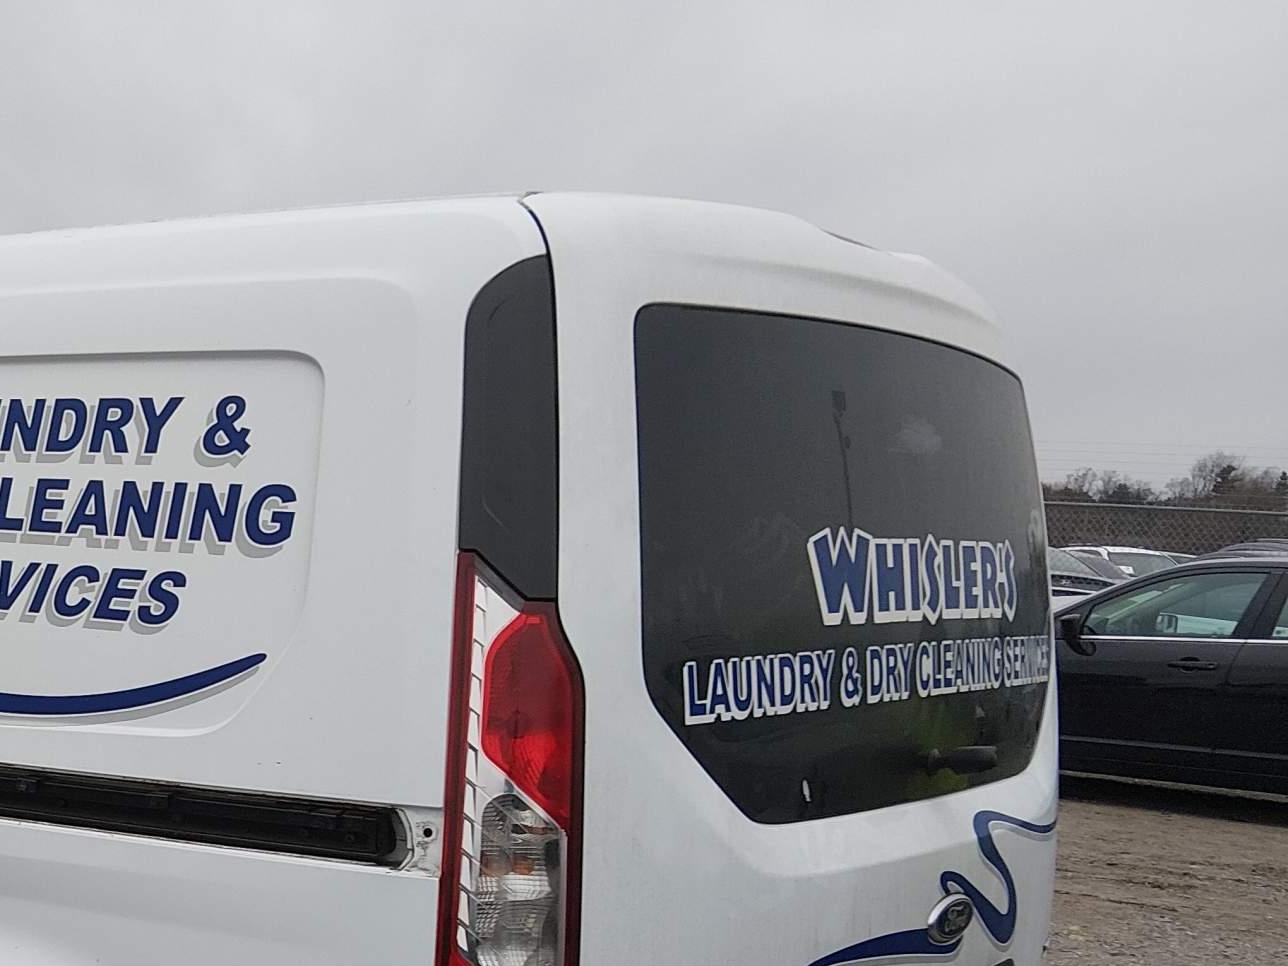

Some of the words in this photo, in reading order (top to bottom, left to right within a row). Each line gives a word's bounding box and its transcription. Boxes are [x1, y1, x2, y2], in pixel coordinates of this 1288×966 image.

[202, 395, 251, 456] &
[807, 526, 1018, 626] WHISLER'S
[683, 650, 835, 725] LAUNDRY
[840, 647, 863, 707] &
[866, 643, 914, 704] DRY
[916, 637, 1003, 698] CLEANING
